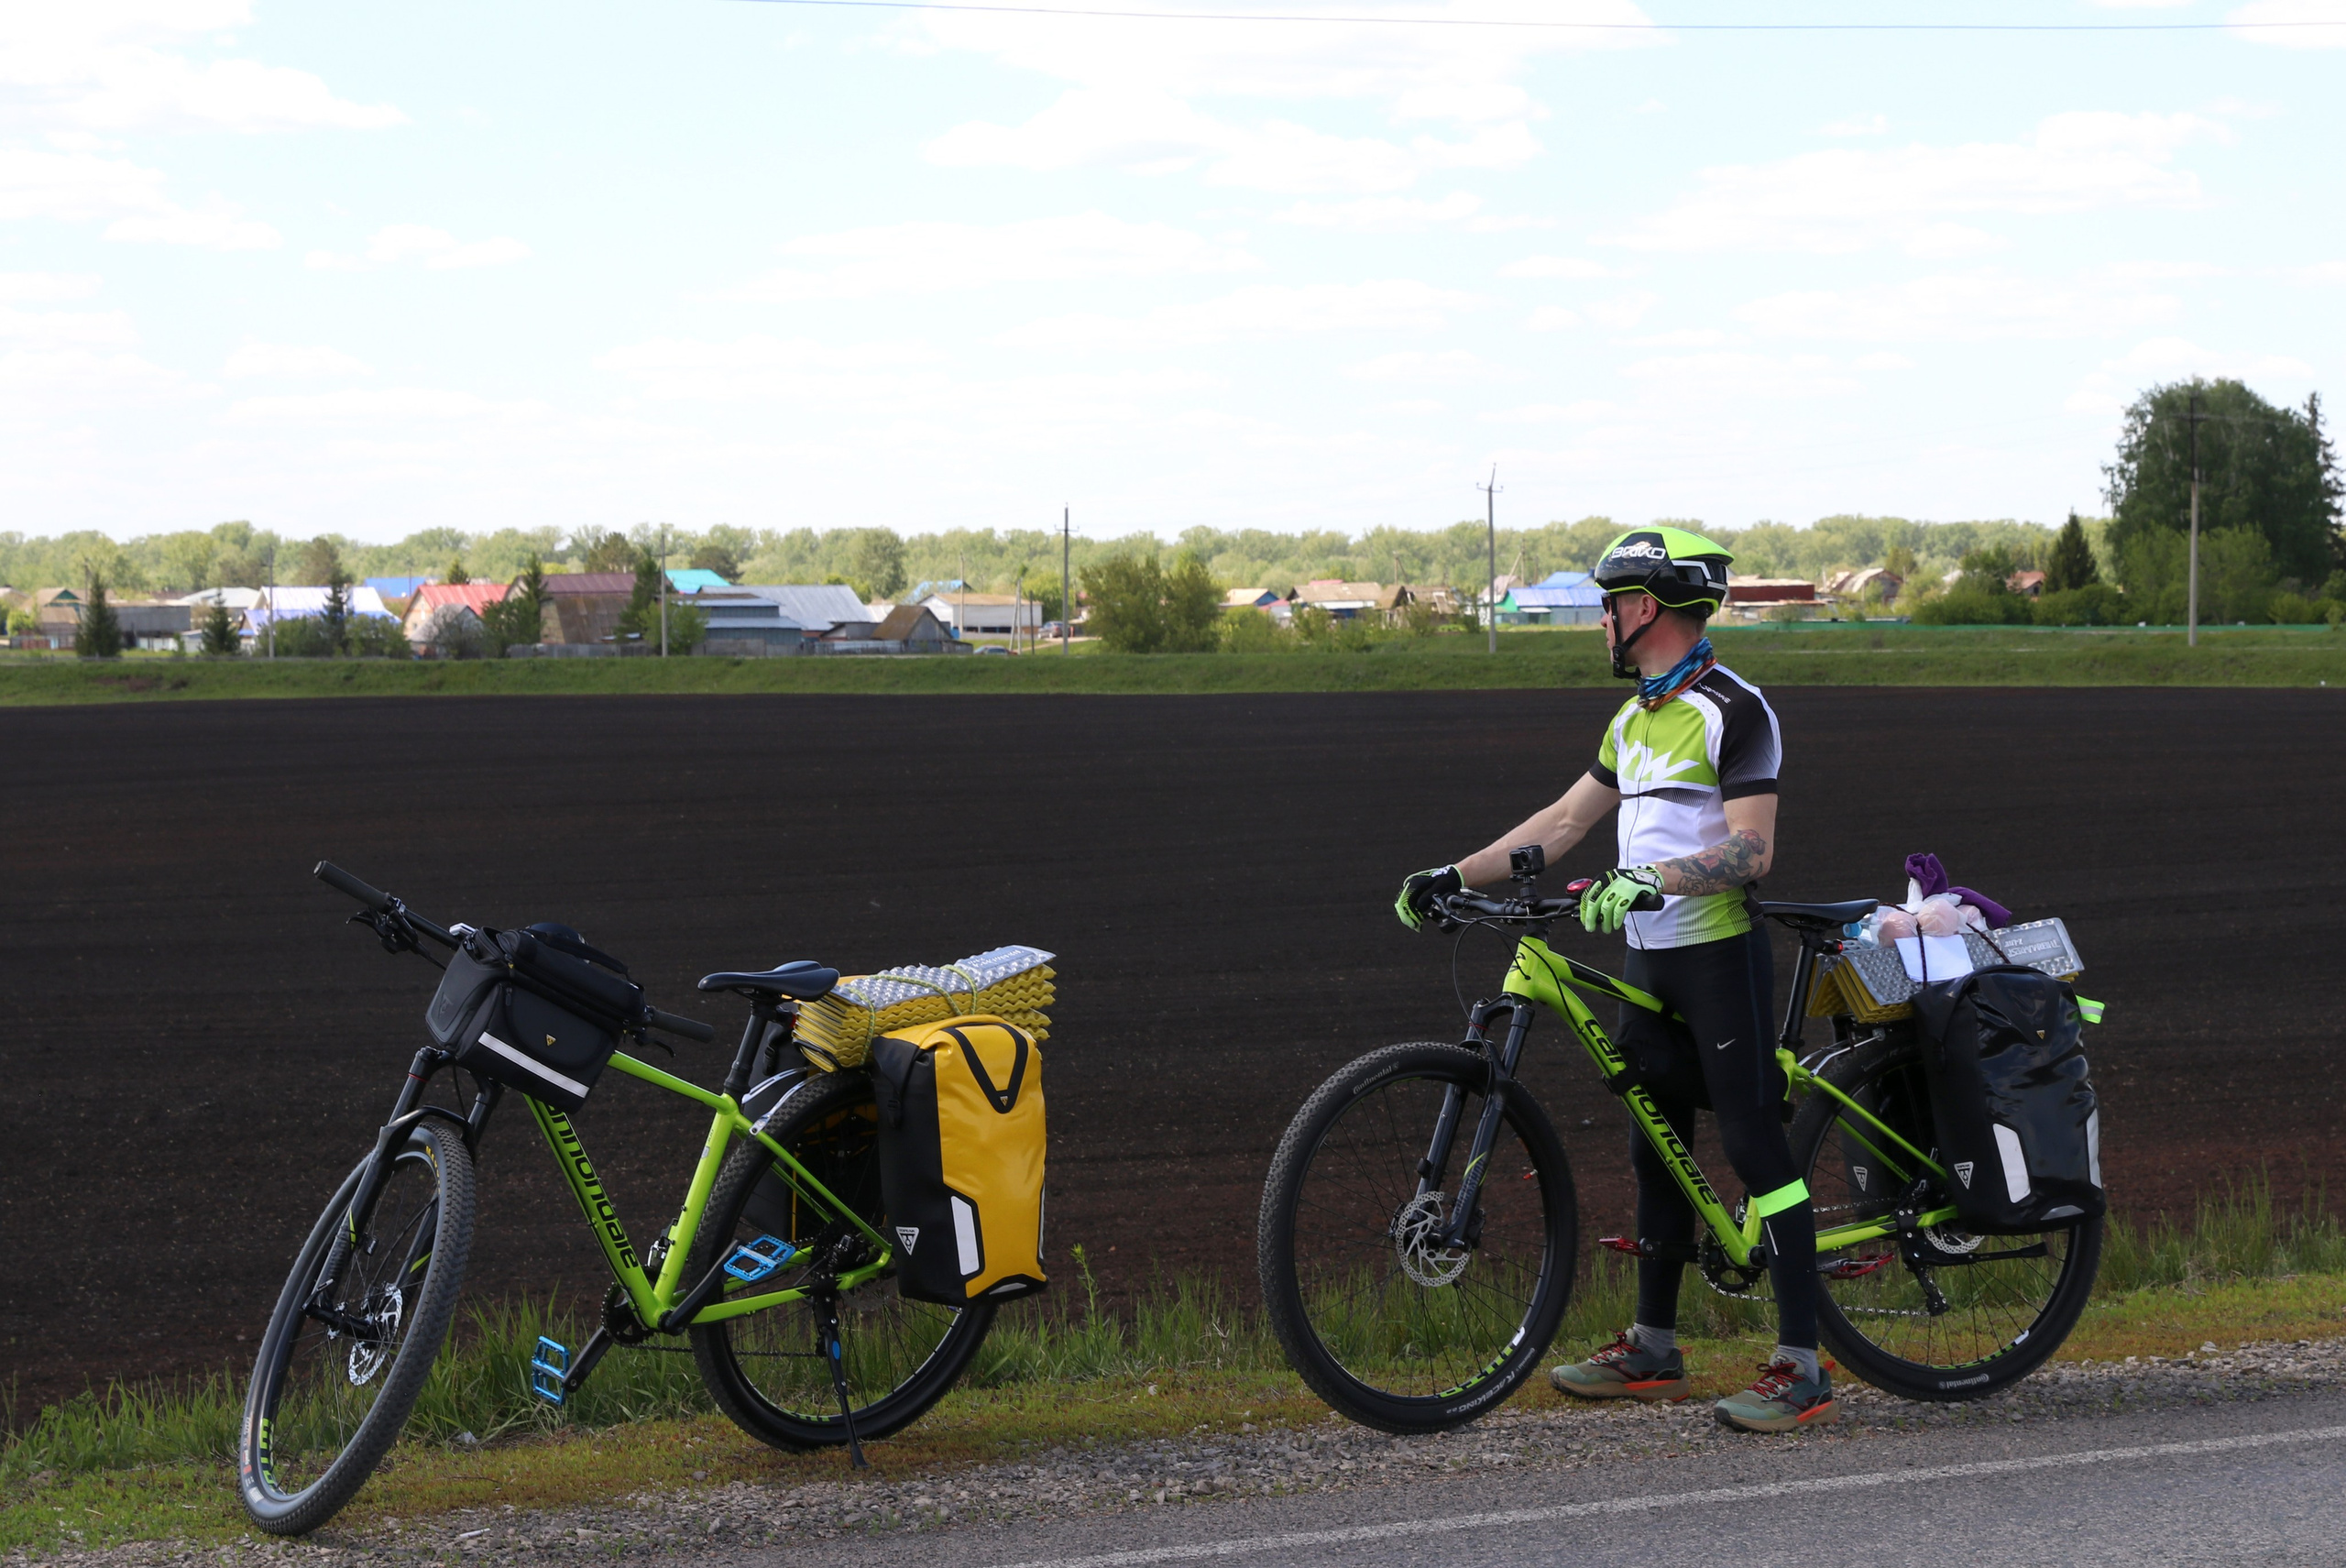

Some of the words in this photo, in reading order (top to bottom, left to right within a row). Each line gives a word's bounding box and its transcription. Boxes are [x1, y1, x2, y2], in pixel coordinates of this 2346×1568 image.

[1611, 545, 1667, 560] BRIKO
[548, 1103, 639, 1269] nnondale
[1946, 1373, 1990, 1389] Continental
